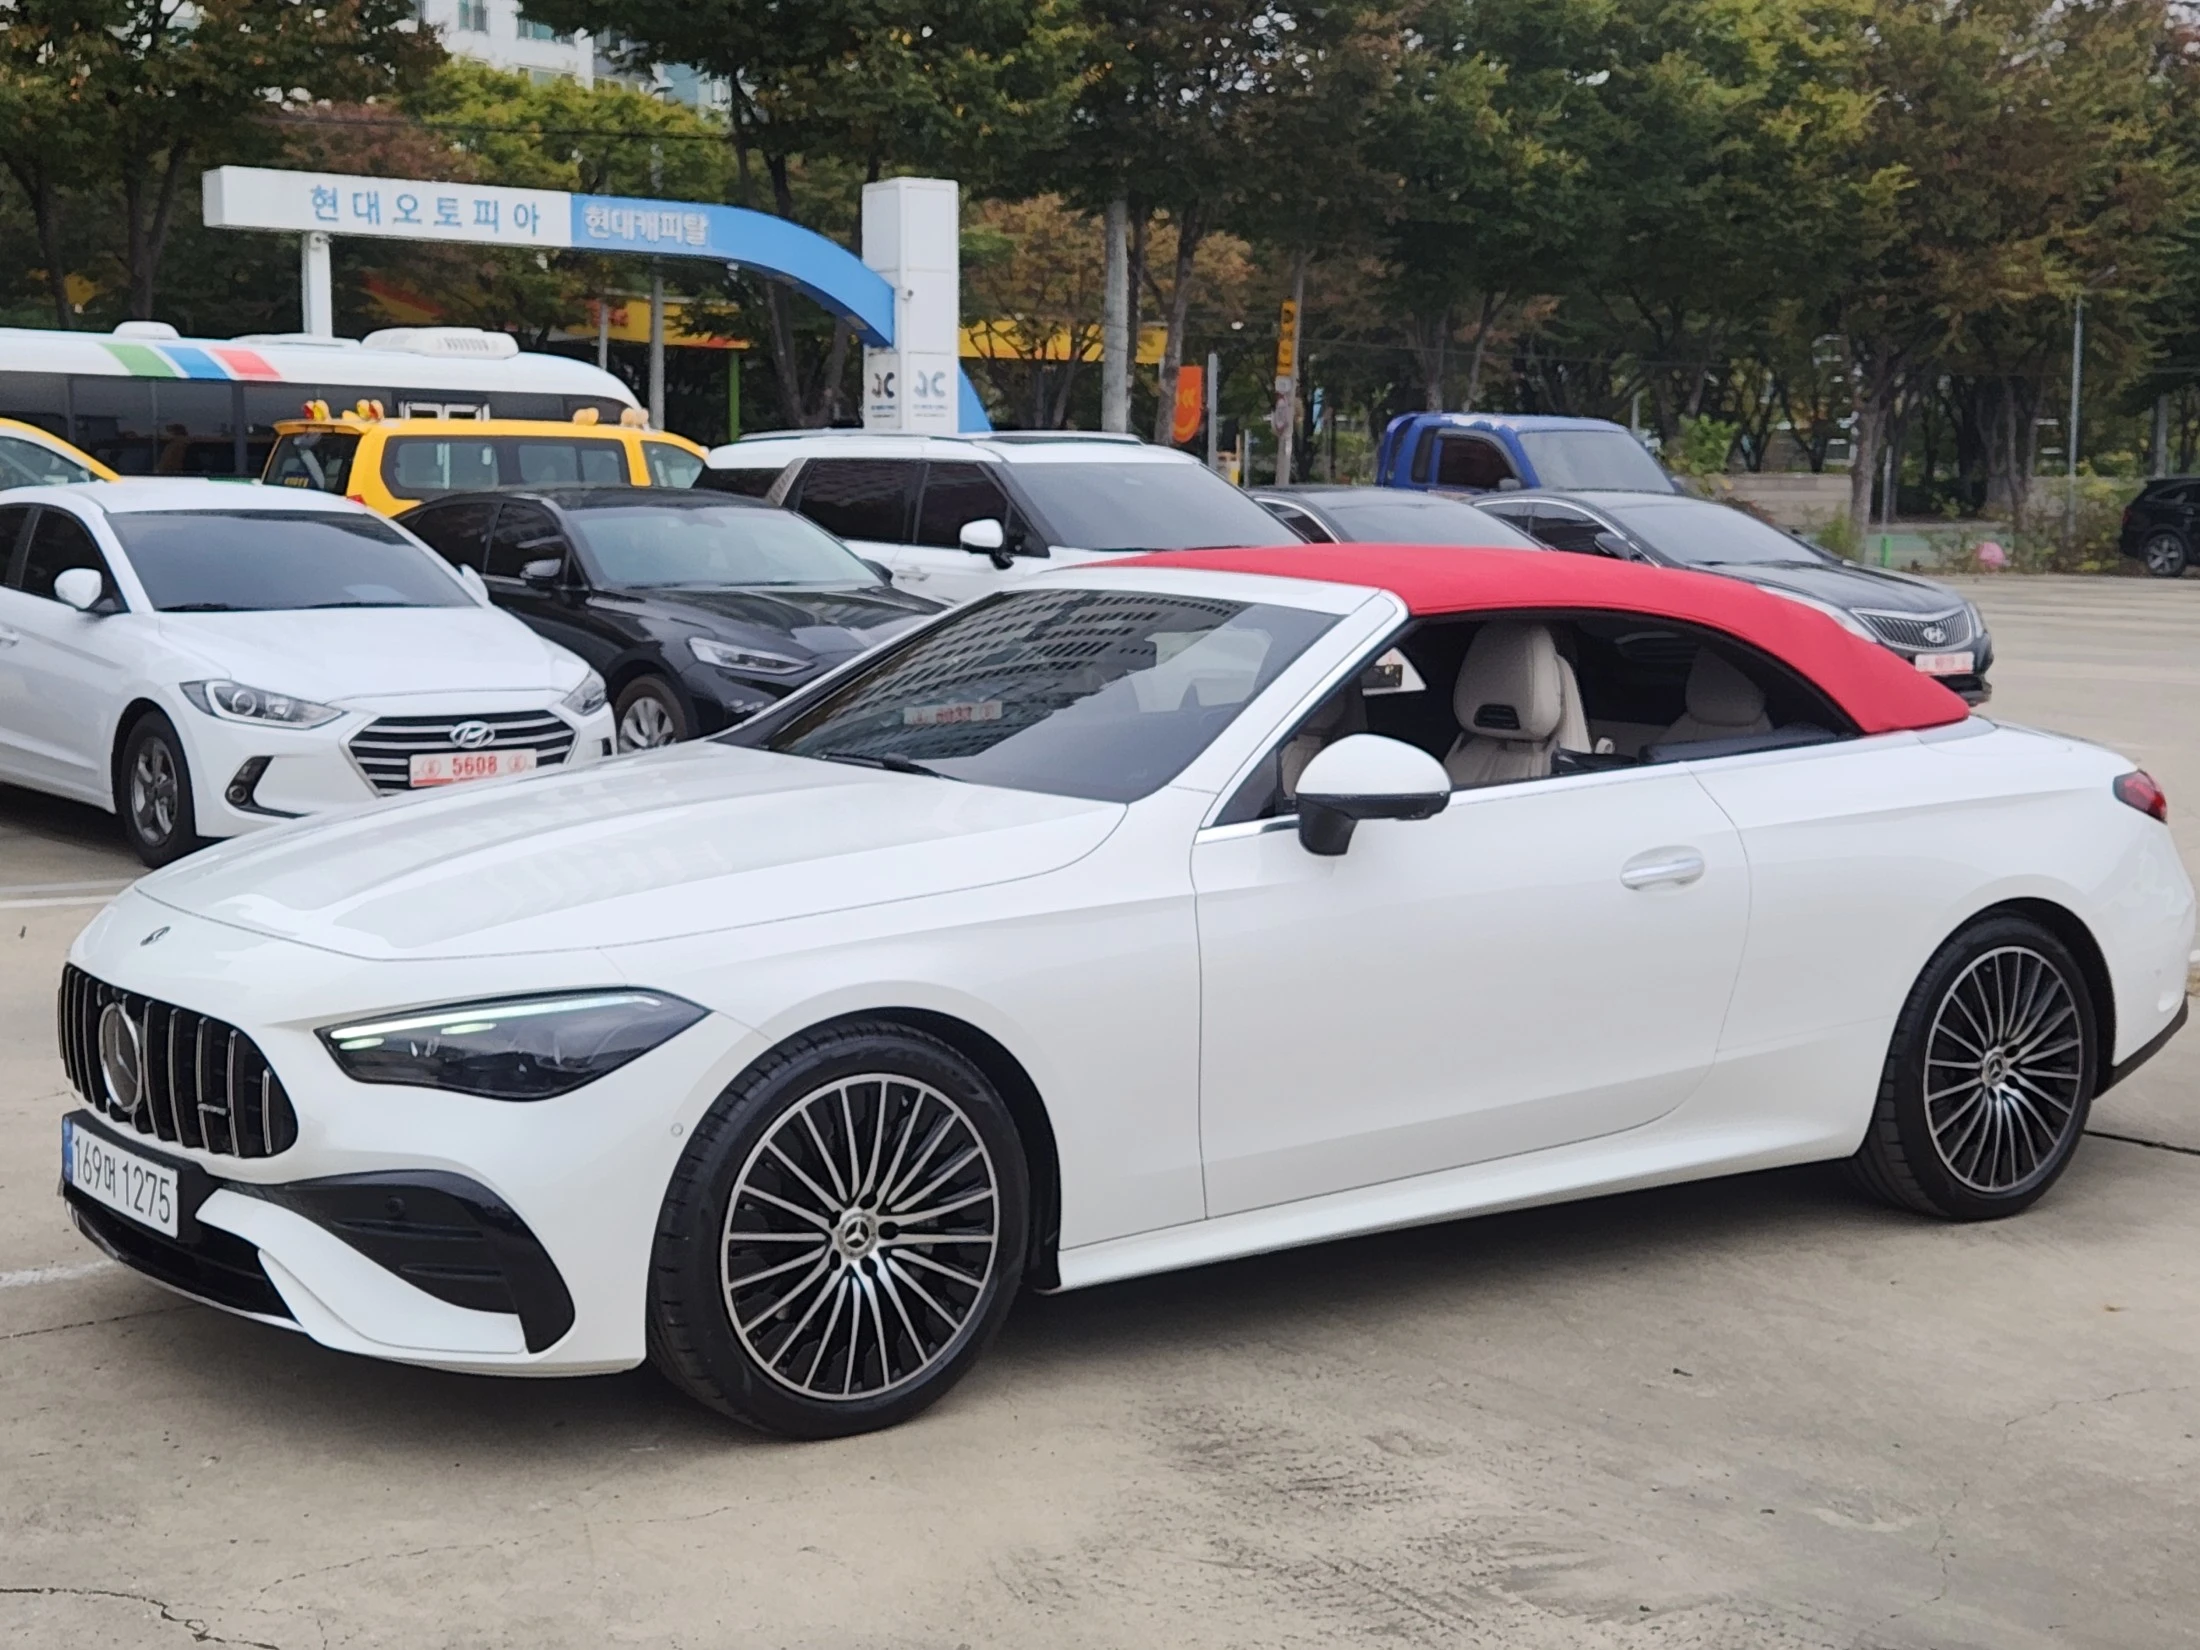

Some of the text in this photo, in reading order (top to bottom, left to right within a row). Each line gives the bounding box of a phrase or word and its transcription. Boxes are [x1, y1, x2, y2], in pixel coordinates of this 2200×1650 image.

[310, 184, 541, 237] 현대오토피아
[584, 204, 709, 246] 현대캐피탈
[452, 755, 498, 776] 5608
[75, 1135, 171, 1224] 169머 1275
